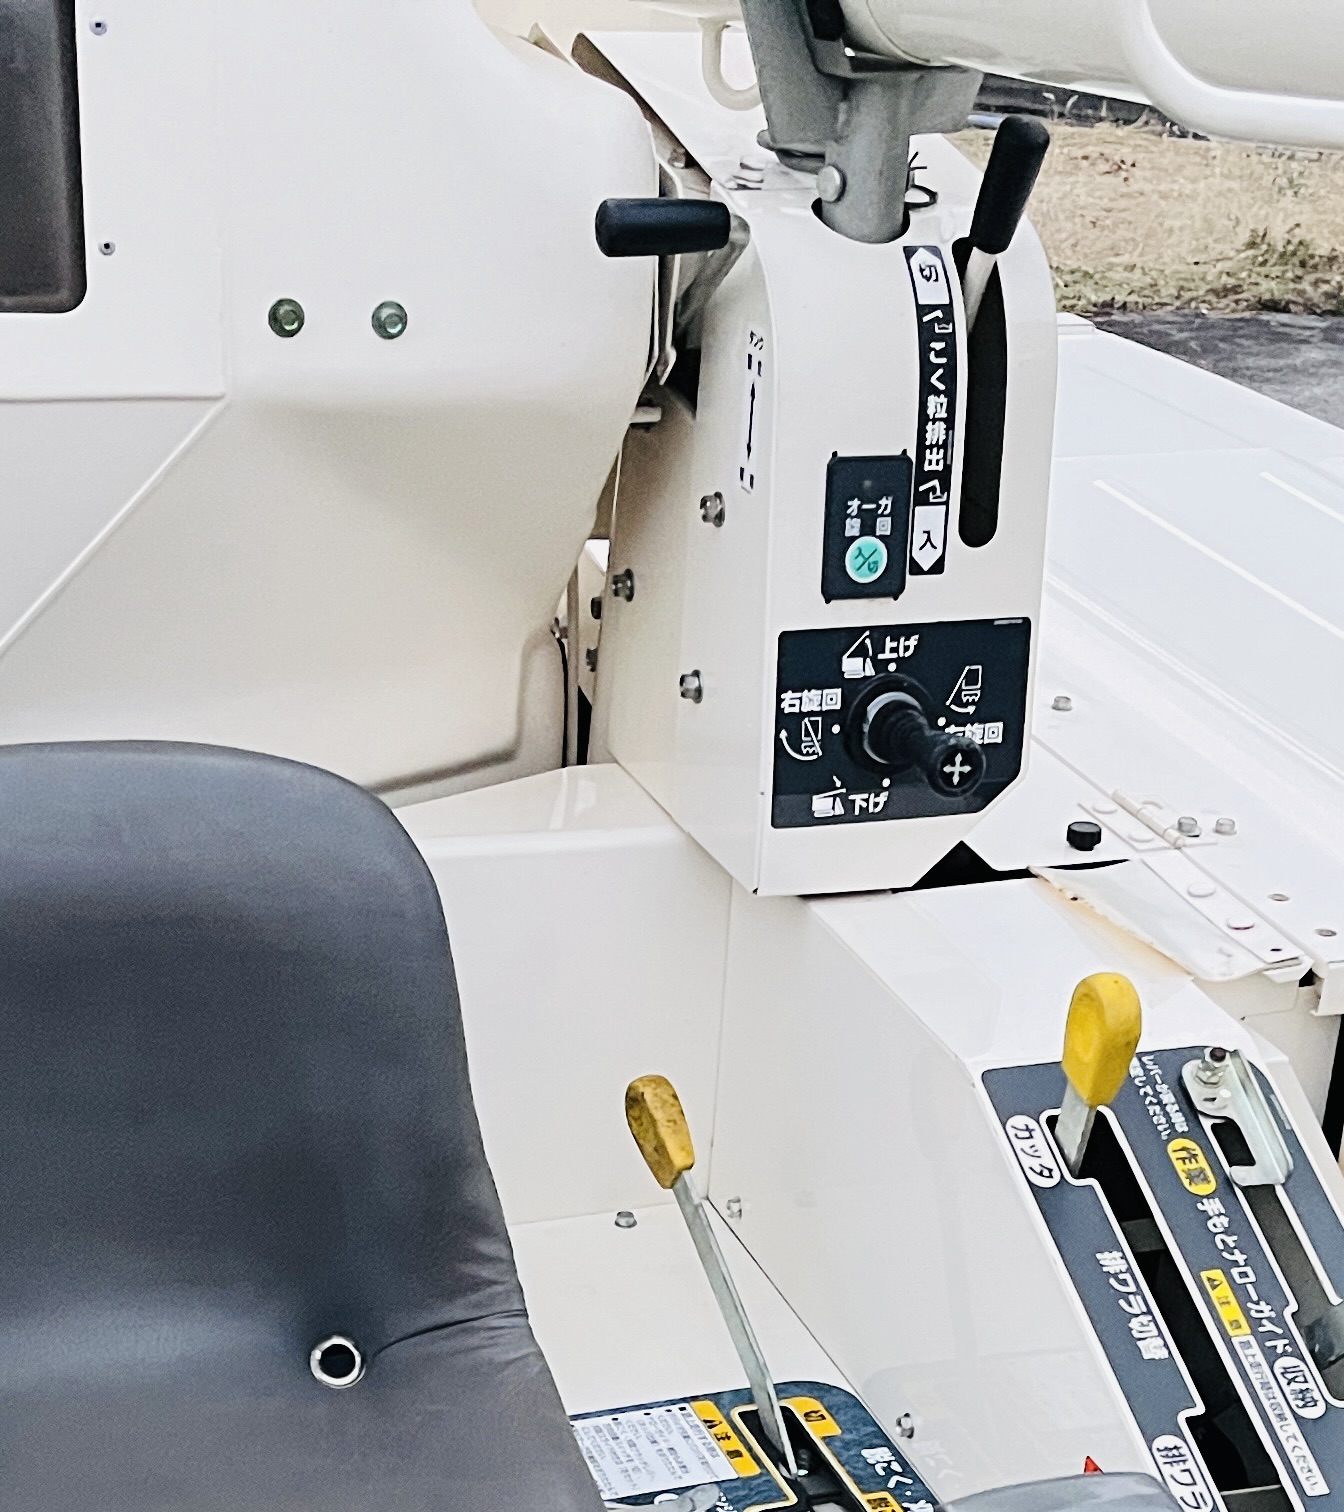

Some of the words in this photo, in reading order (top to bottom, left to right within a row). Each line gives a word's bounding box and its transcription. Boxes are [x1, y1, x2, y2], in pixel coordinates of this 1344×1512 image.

[919, 264, 939, 284] 切
[924, 340, 948, 472] こく粒排出
[846, 498, 893, 516] オーガ
[919, 531, 938, 551] 入
[878, 635, 919, 659] 上げ
[780, 690, 842, 714] 右旋回
[849, 793, 889, 815] 下げ
[1010, 1122, 1057, 1183] カッタ
[1197, 1197, 1293, 1355] 手もとナローガイド
[1096, 1250, 1170, 1361] 排ワラ切替
[1279, 1362, 1322, 1411] 収納
[1156, 1442, 1209, 1512] 排ワラ
